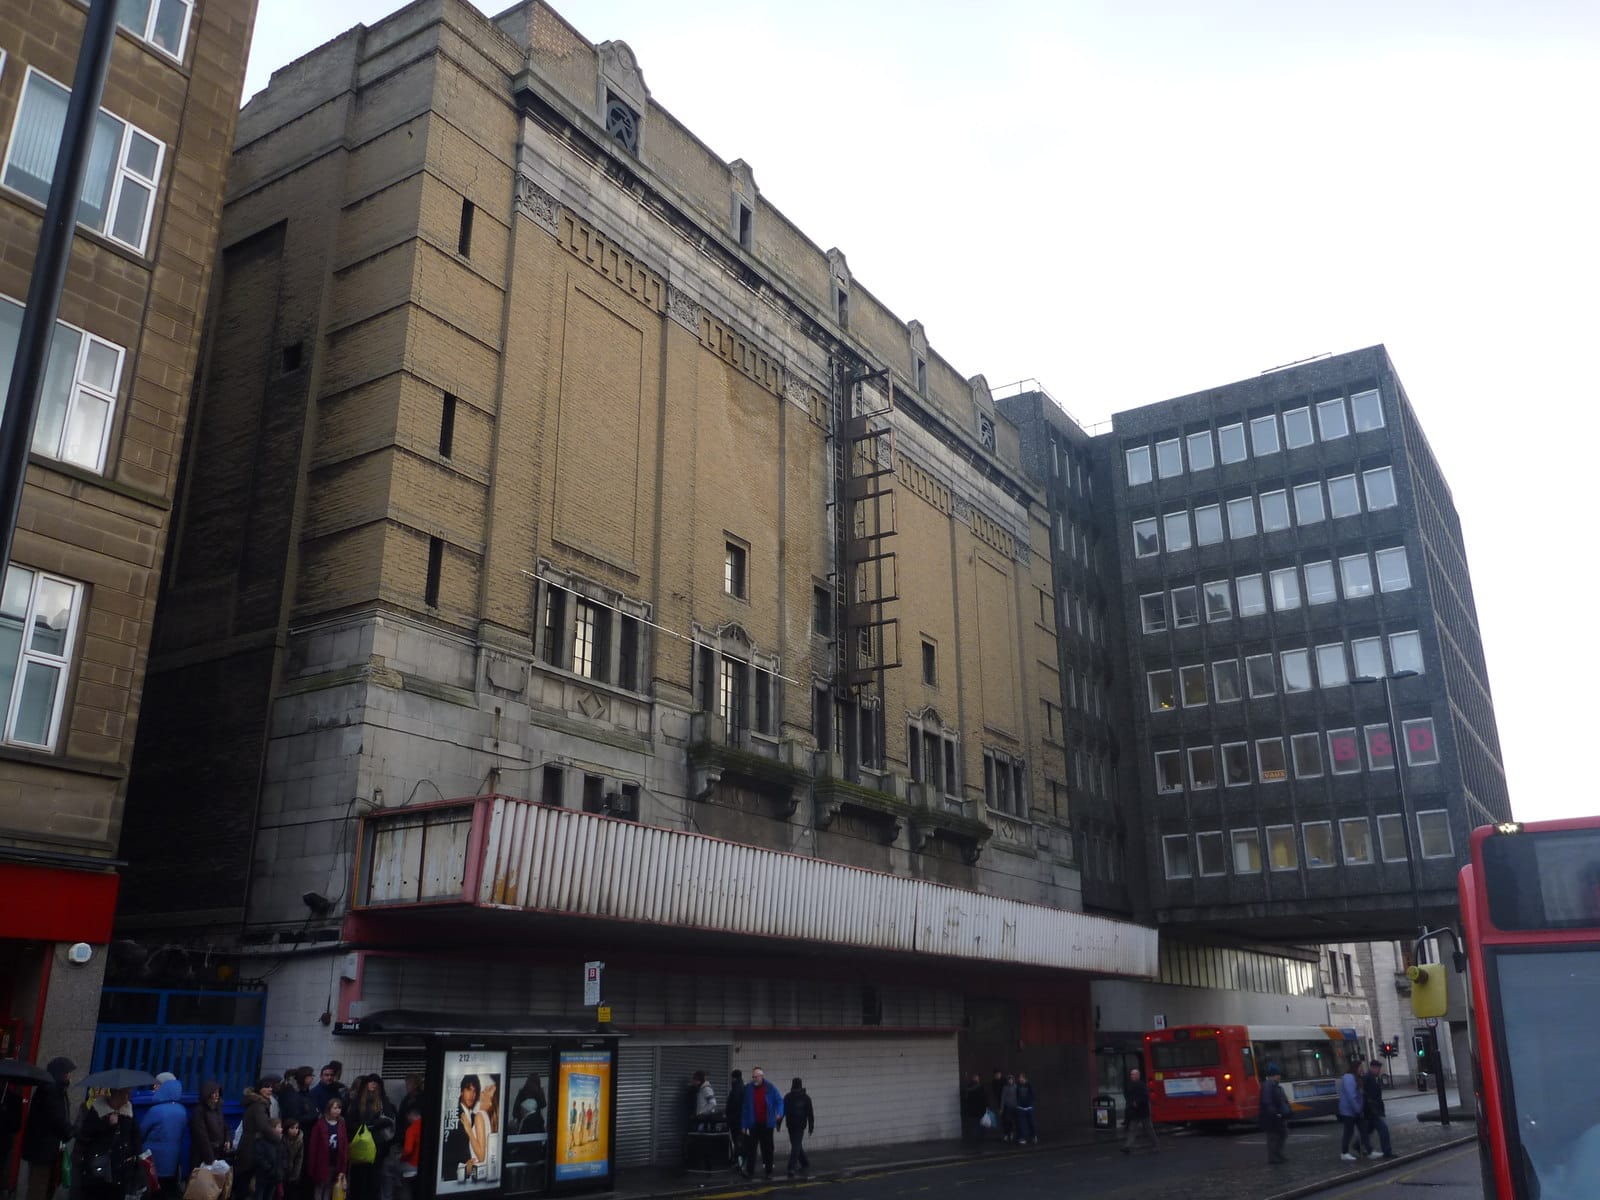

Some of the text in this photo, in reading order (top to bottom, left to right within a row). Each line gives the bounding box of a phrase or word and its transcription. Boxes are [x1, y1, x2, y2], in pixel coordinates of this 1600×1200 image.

[1408, 728, 1433, 752] D
[458, 1053, 470, 1062] 212
[444, 1118, 460, 1130] LIST
